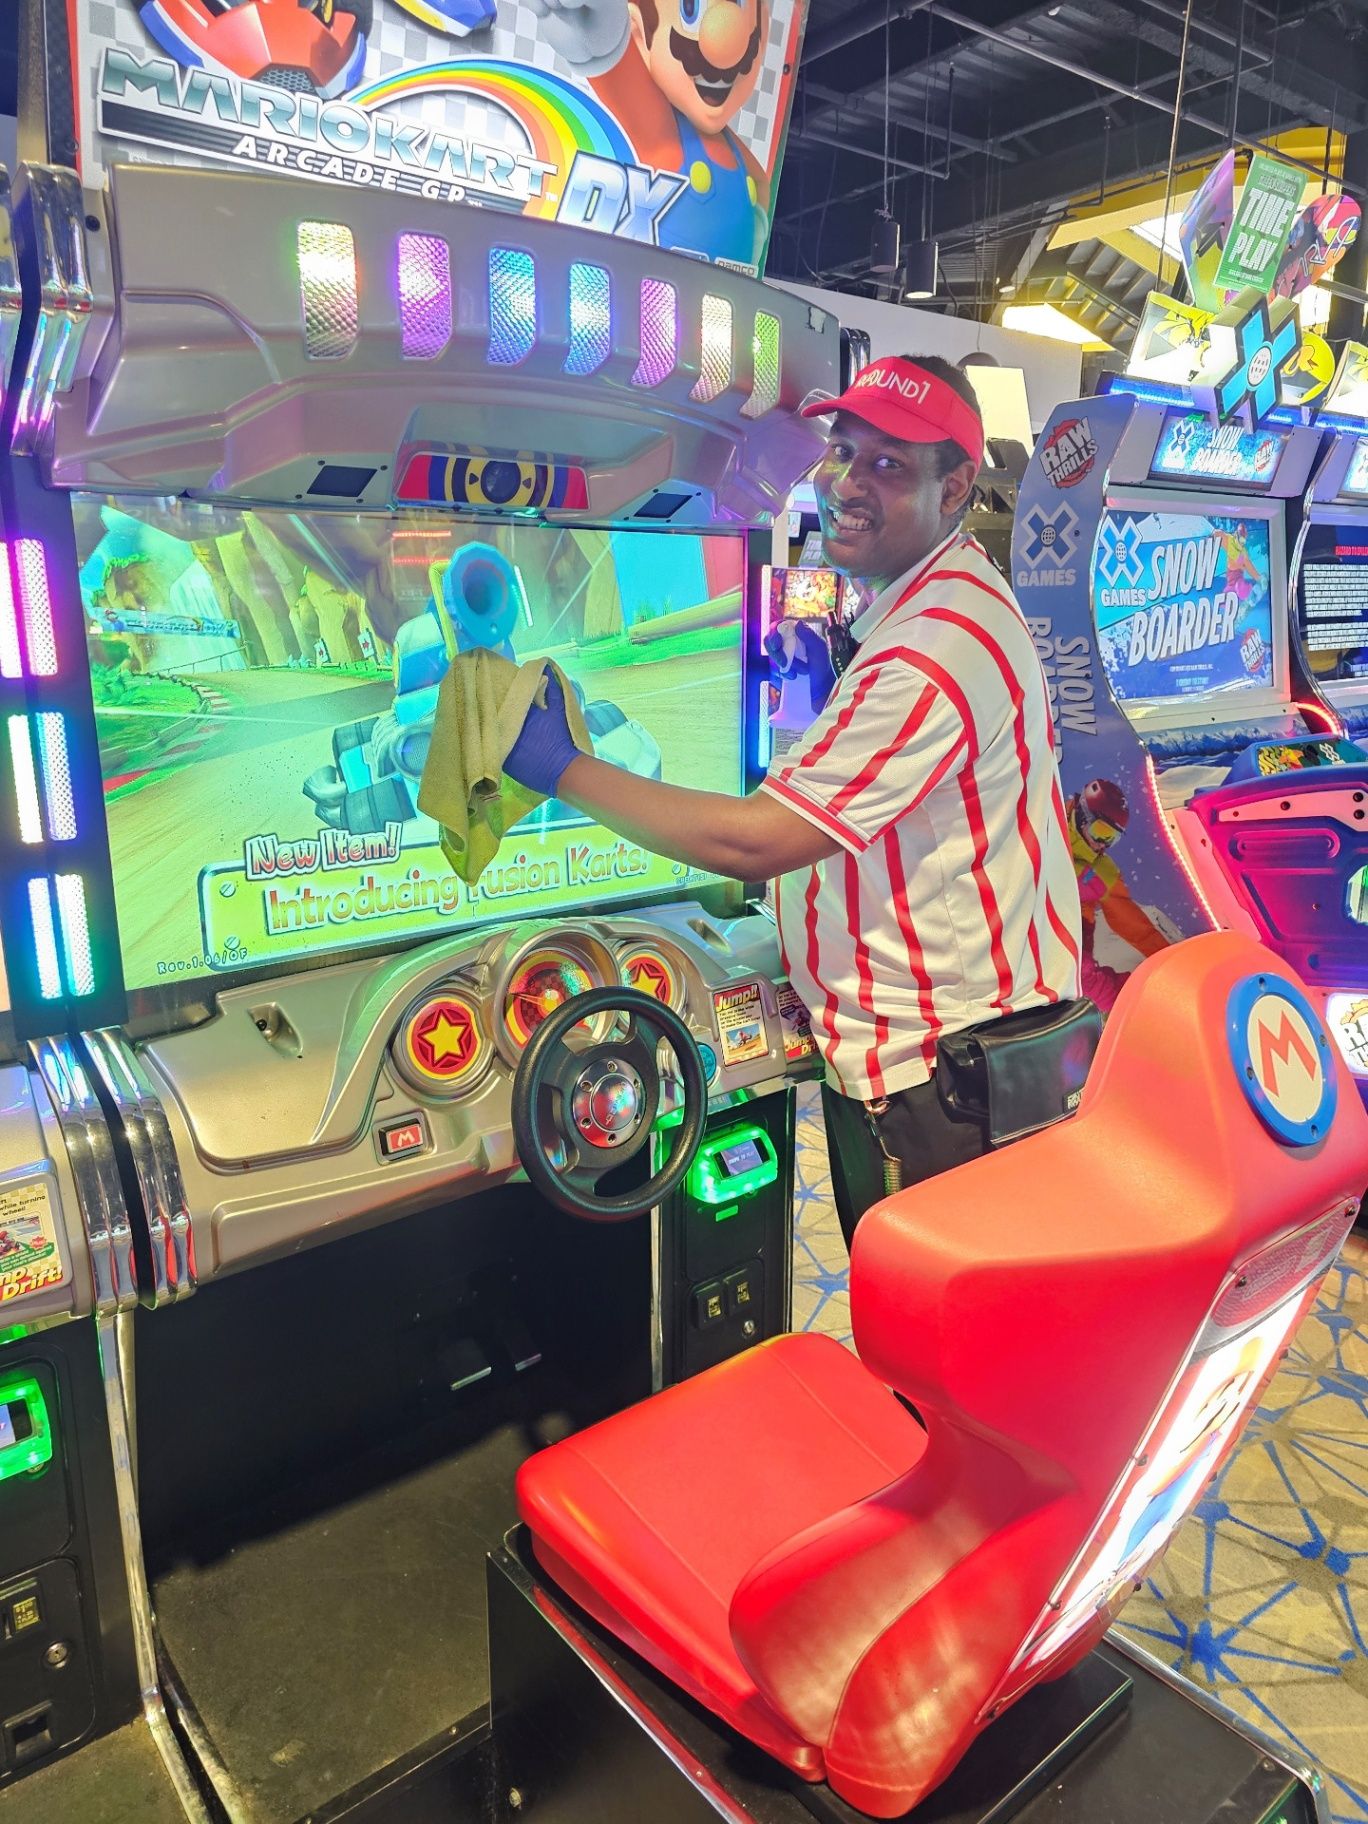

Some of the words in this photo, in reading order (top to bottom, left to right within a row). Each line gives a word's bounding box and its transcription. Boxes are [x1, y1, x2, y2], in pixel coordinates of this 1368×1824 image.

[231, 134, 400, 191] ARCADE
[420, 178, 467, 204] GP
[556, 150, 690, 244] DX
[1240, 187, 1295, 238] TIME
[1228, 231, 1278, 272] PLAY
[855, 369, 931, 404] ROUND1
[1039, 416, 1092, 475] RAW
[1047, 439, 1099, 487] THRILLS
[1017, 568, 1077, 588] GAMES
[1148, 536, 1223, 601] SNOW
[1101, 588, 1147, 608] GAMES
[1128, 591, 1239, 667] BOARDER
[1055, 636, 1098, 736] SNOW
[248, 835, 319, 876] New
[323, 821, 401, 866] Item!
[269, 869, 460, 930] Introducing
[714, 984, 759, 1013] Jump!!
[1, 1264, 63, 1301] Drift!
